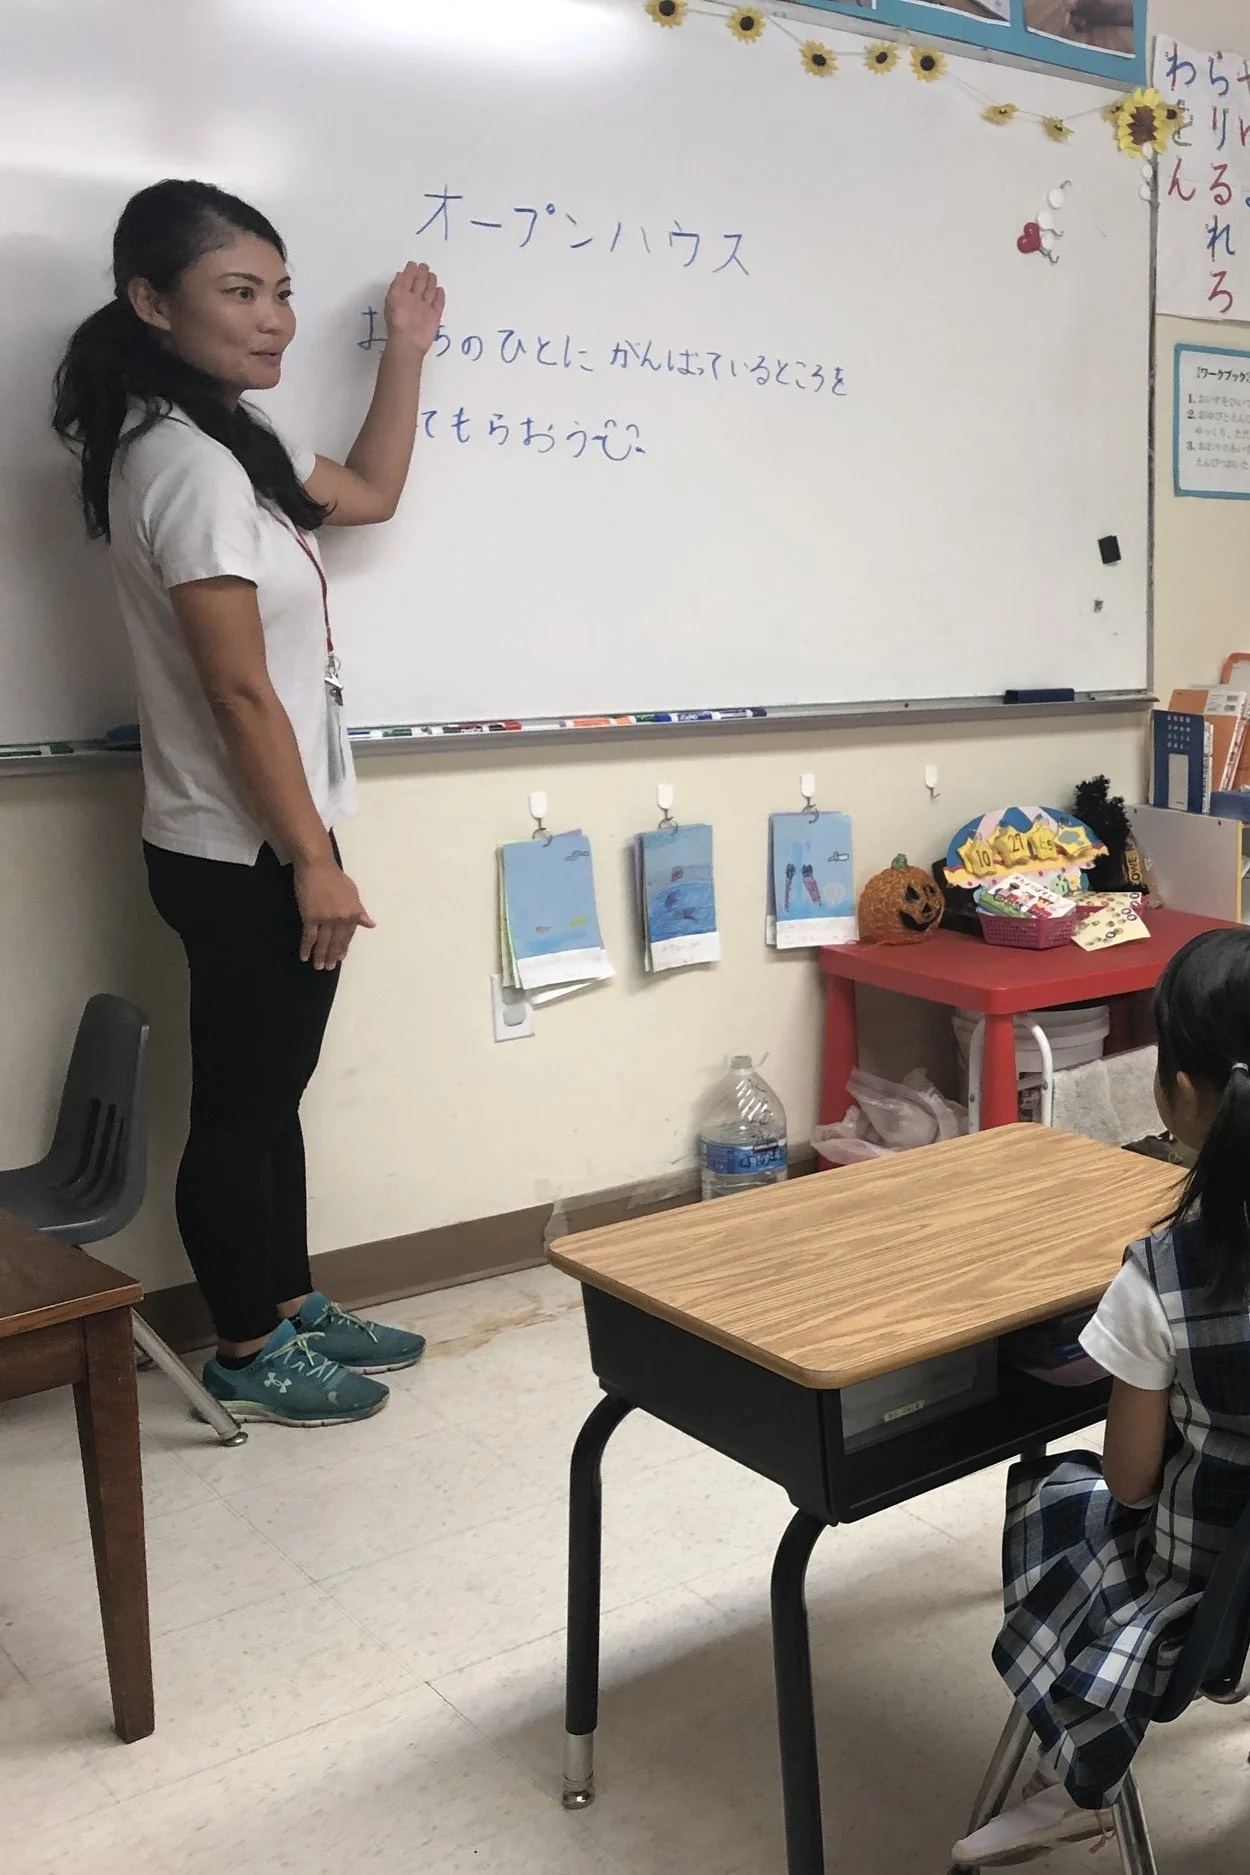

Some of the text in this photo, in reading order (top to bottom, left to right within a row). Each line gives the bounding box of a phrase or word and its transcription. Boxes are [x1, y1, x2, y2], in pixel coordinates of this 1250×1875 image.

[1206, 51, 1236, 314] らりるれろ
[416, 184, 749, 275] オープンハウス
[417, 407, 587, 458] てもらおう
[976, 849, 991, 868] 10
